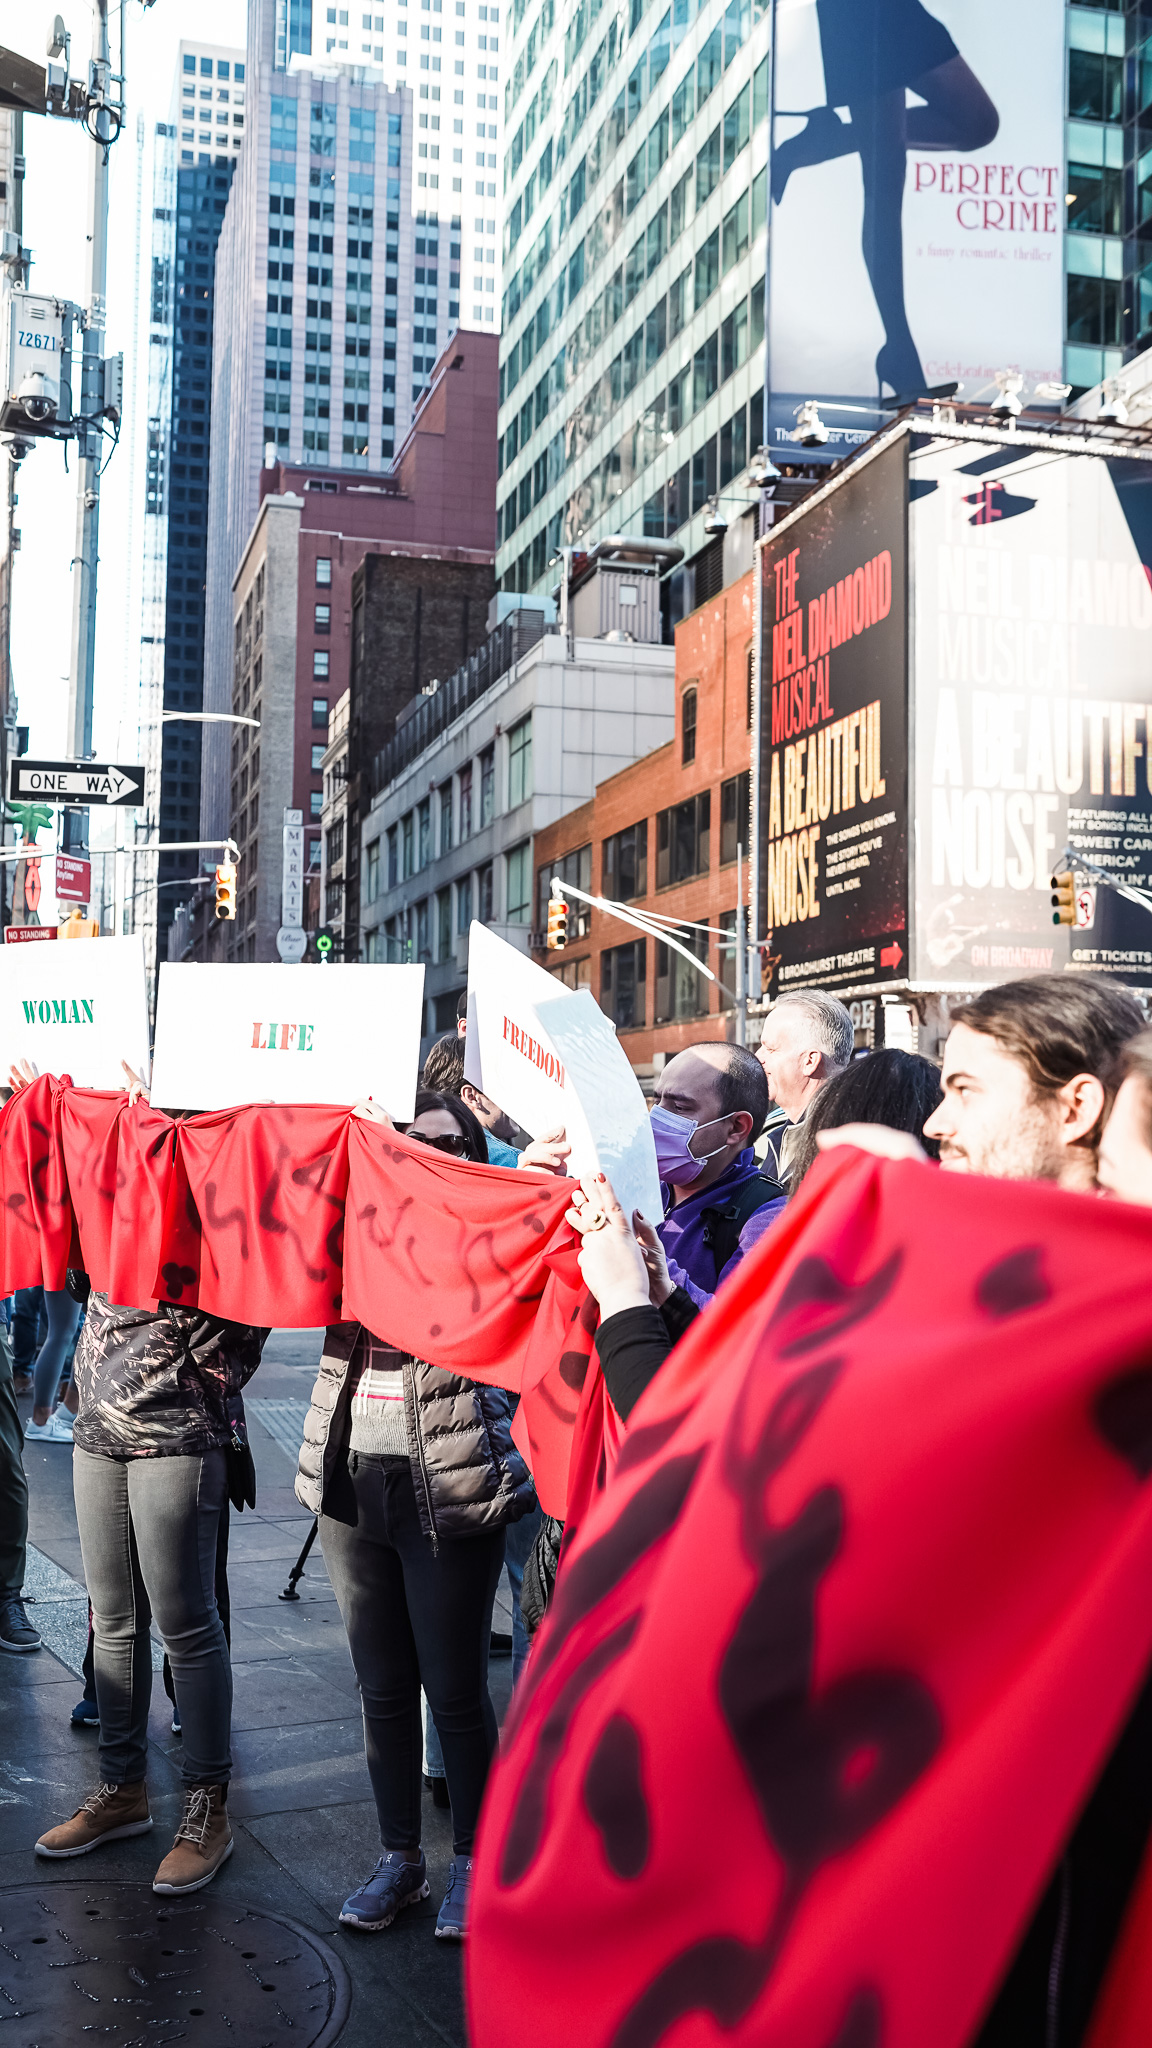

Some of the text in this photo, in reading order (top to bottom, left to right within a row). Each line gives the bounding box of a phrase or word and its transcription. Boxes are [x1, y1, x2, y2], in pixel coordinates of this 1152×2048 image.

[914, 162, 1058, 197] PERFECT
[957, 199, 1057, 232] CRIME
[18, 330, 56, 351] 72671
[925, 360, 998, 378] Celebratin
[773, 547, 800, 621] THE
[938, 545, 1022, 619] NEIL
[772, 549, 892, 684] NEIL DIAMOND
[938, 613, 1089, 692] MUSICAL
[772, 655, 834, 745] MUSICAL
[932, 687, 1152, 797] A BEAUTIF
[30, 773, 124, 793] ONE WAY
[768, 699, 886, 840] A BEAUTIFUL
[1067, 808, 1148, 823] FEATURING ALL
[1087, 820, 1125, 832] SONGS
[932, 787, 1059, 891] NOISE
[288, 831, 300, 922] MARAIS
[767, 824, 820, 929] NOISE
[8, 929, 50, 940] NO STANDING
[785, 956, 835, 980] BROADHURST
[836, 946, 875, 969] THEATRE
[992, 946, 1054, 968] BROADWAY
[1072, 949, 1152, 964] GET TICKETS
[22, 999, 94, 1024] WOMAN
[251, 1022, 314, 1051] LIFE
[502, 1015, 565, 1090] FREEDOM
